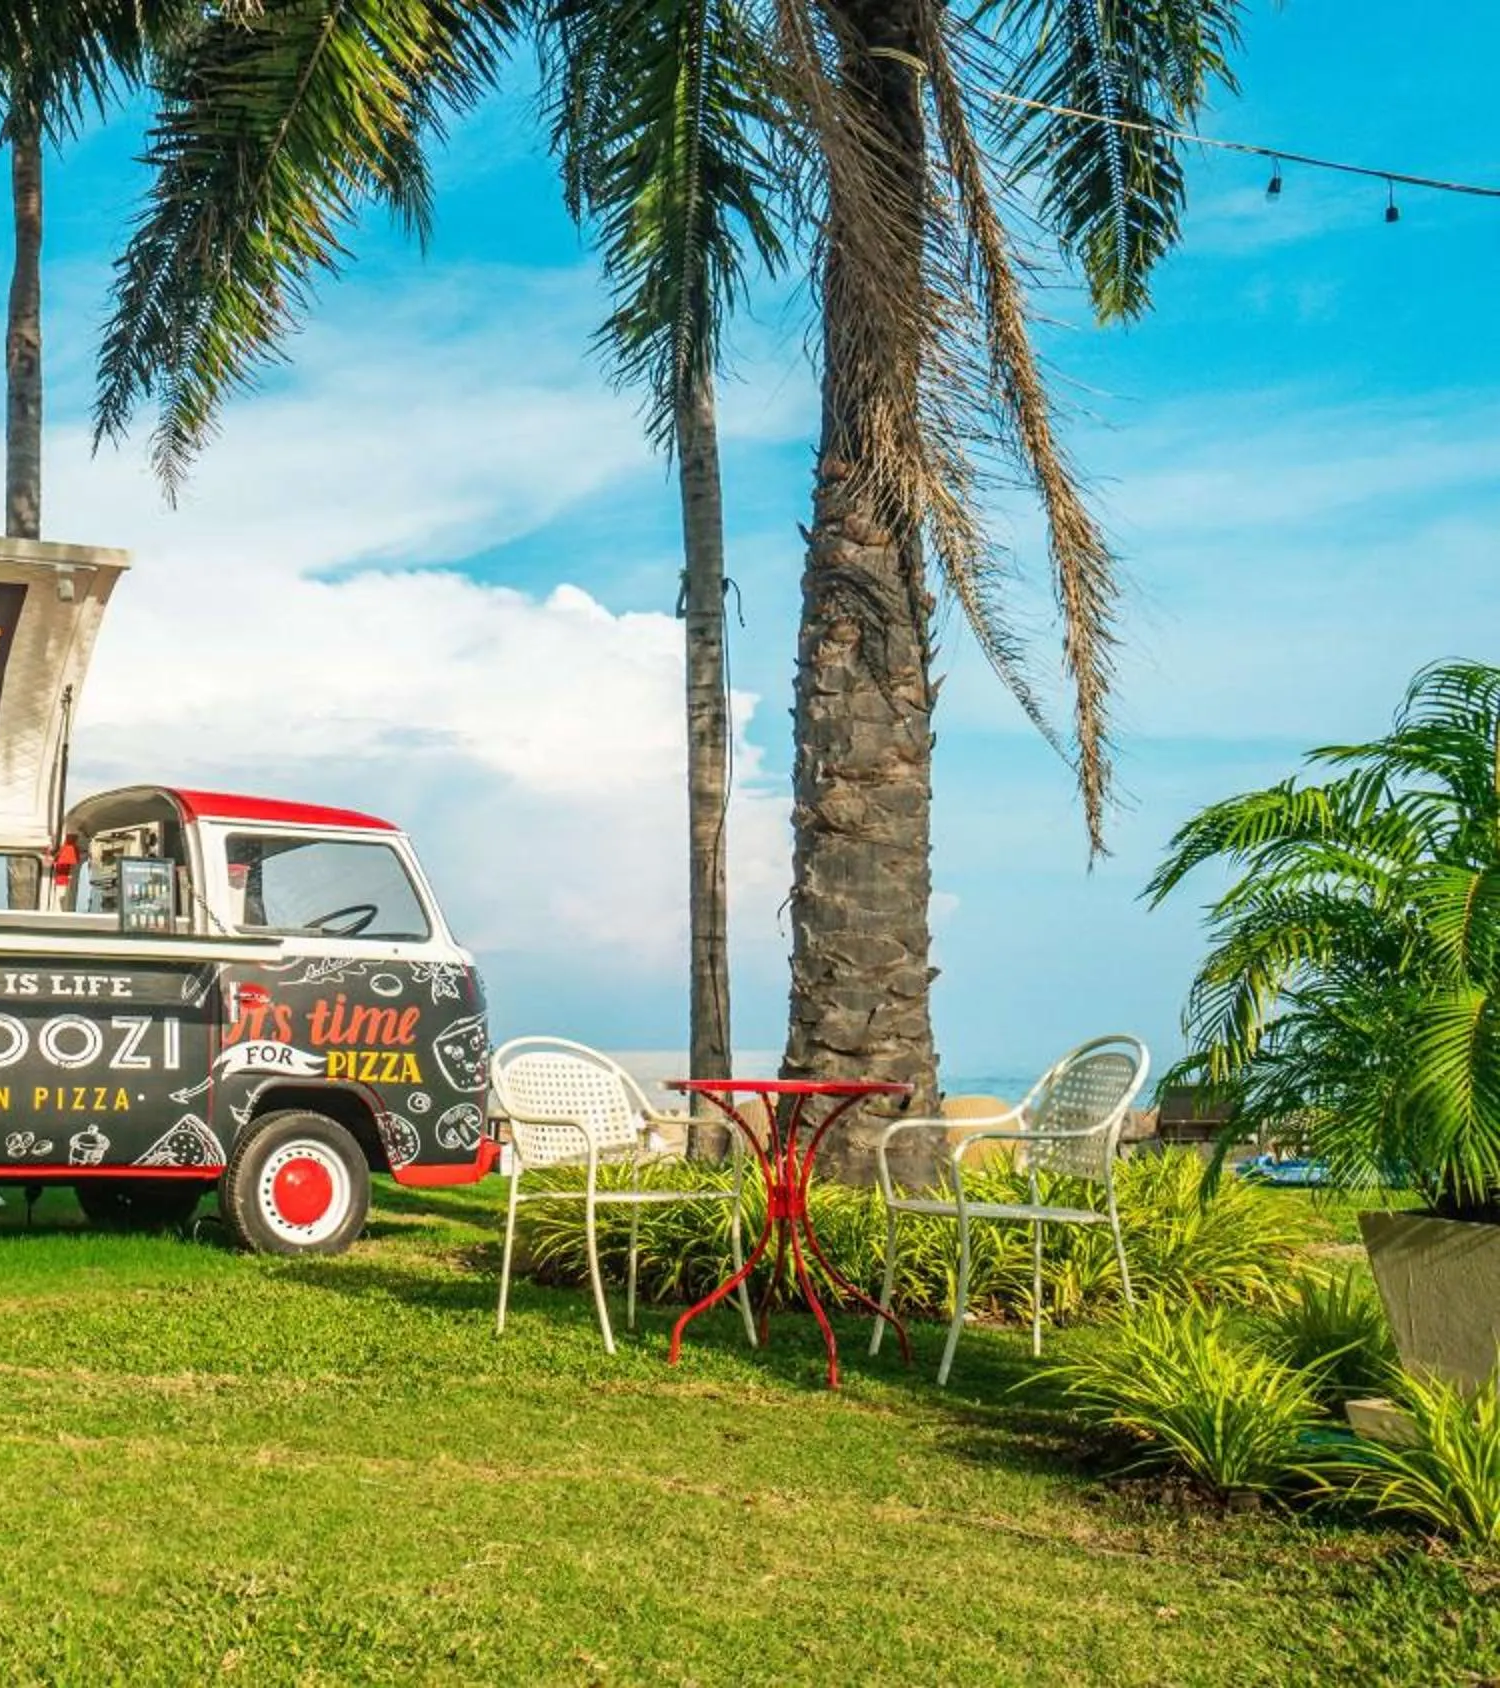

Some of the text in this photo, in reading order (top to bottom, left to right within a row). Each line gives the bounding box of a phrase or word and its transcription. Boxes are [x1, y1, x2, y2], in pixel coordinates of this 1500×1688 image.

[4, 973, 40, 995] IS
[51, 974, 133, 997] LIFE
[305, 993, 421, 1045] time
[245, 1046, 293, 1065] FOR
[325, 1050, 423, 1083] PIZZA
[33, 1086, 131, 1111] PIZZA
